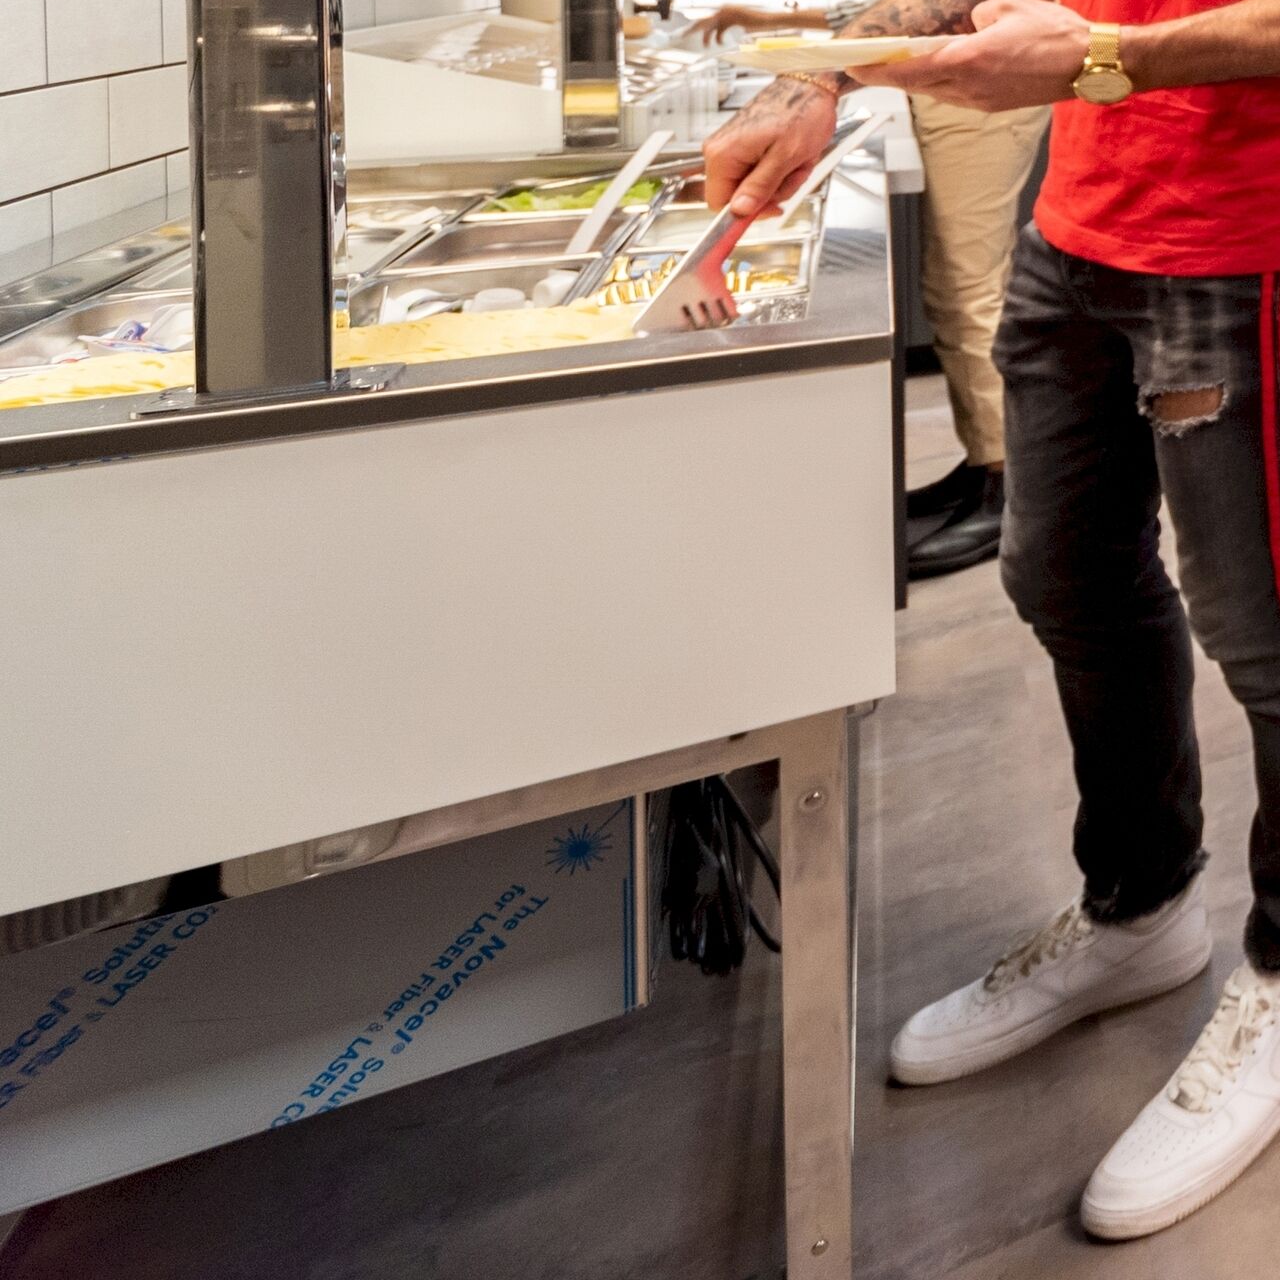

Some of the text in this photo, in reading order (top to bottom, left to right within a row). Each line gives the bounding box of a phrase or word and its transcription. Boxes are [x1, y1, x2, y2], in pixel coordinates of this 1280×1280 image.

[495, 884, 526, 910] for
[503, 895, 549, 931] The
[431, 913, 497, 970] LASER
[18, 1024, 84, 1077] Fiber
[97, 943, 177, 1007] LASER
[383, 973, 436, 1021] Fiber
[366, 1022, 384, 1033] &
[302, 1037, 372, 1099] LASER
